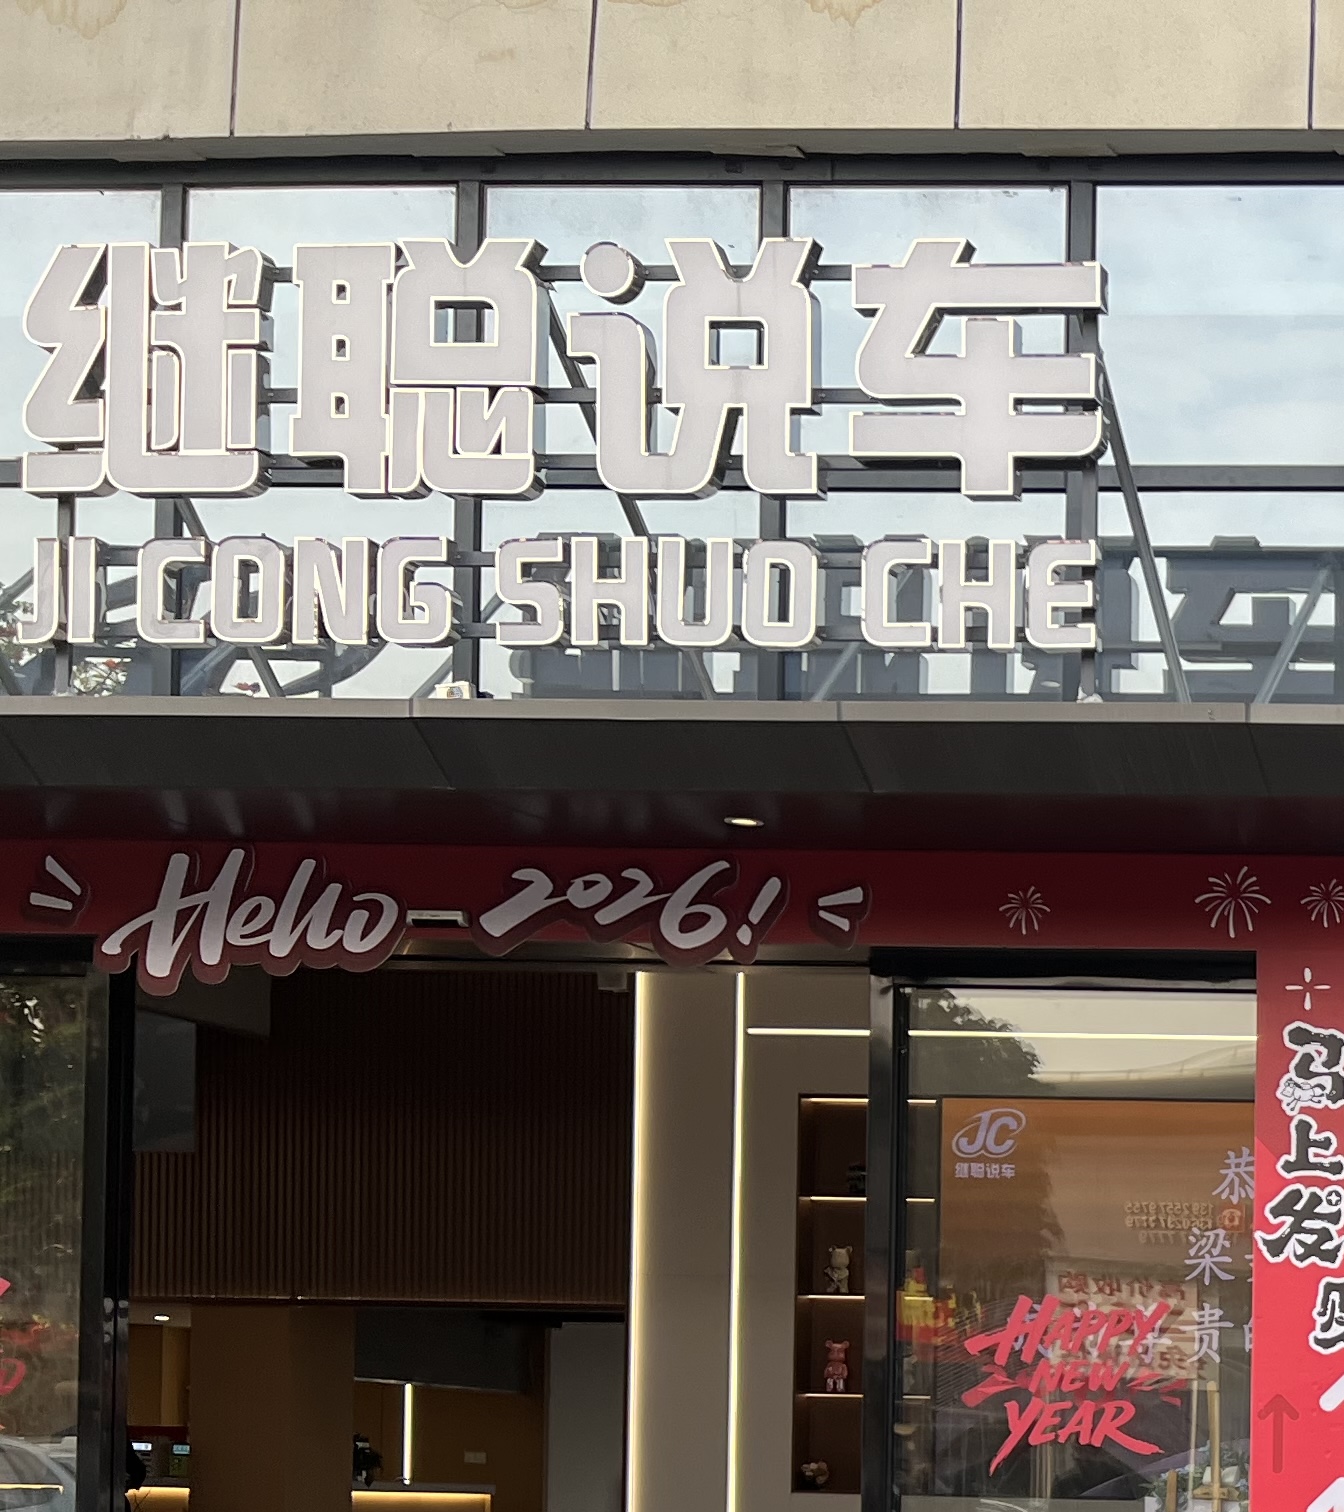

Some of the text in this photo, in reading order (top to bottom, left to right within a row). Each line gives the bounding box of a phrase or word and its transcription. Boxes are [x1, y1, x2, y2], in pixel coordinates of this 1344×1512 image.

[22, 238, 1104, 496] 继聪说车
[17, 536, 98, 646] JI
[137, 536, 454, 646] CONG
[497, 536, 818, 647] SHUO
[861, 538, 1099, 650] CHE
[102, 848, 782, 977] Hello 2026!
[957, 1110, 1020, 1156] JC
[955, 1162, 1016, 1179] 继聪说车
[1184, 1227, 1255, 1286] 梁
[964, 1294, 1171, 1367] HAPPY
[1028, 1360, 1131, 1394] NEW
[988, 1399, 1166, 1477] YEAR
